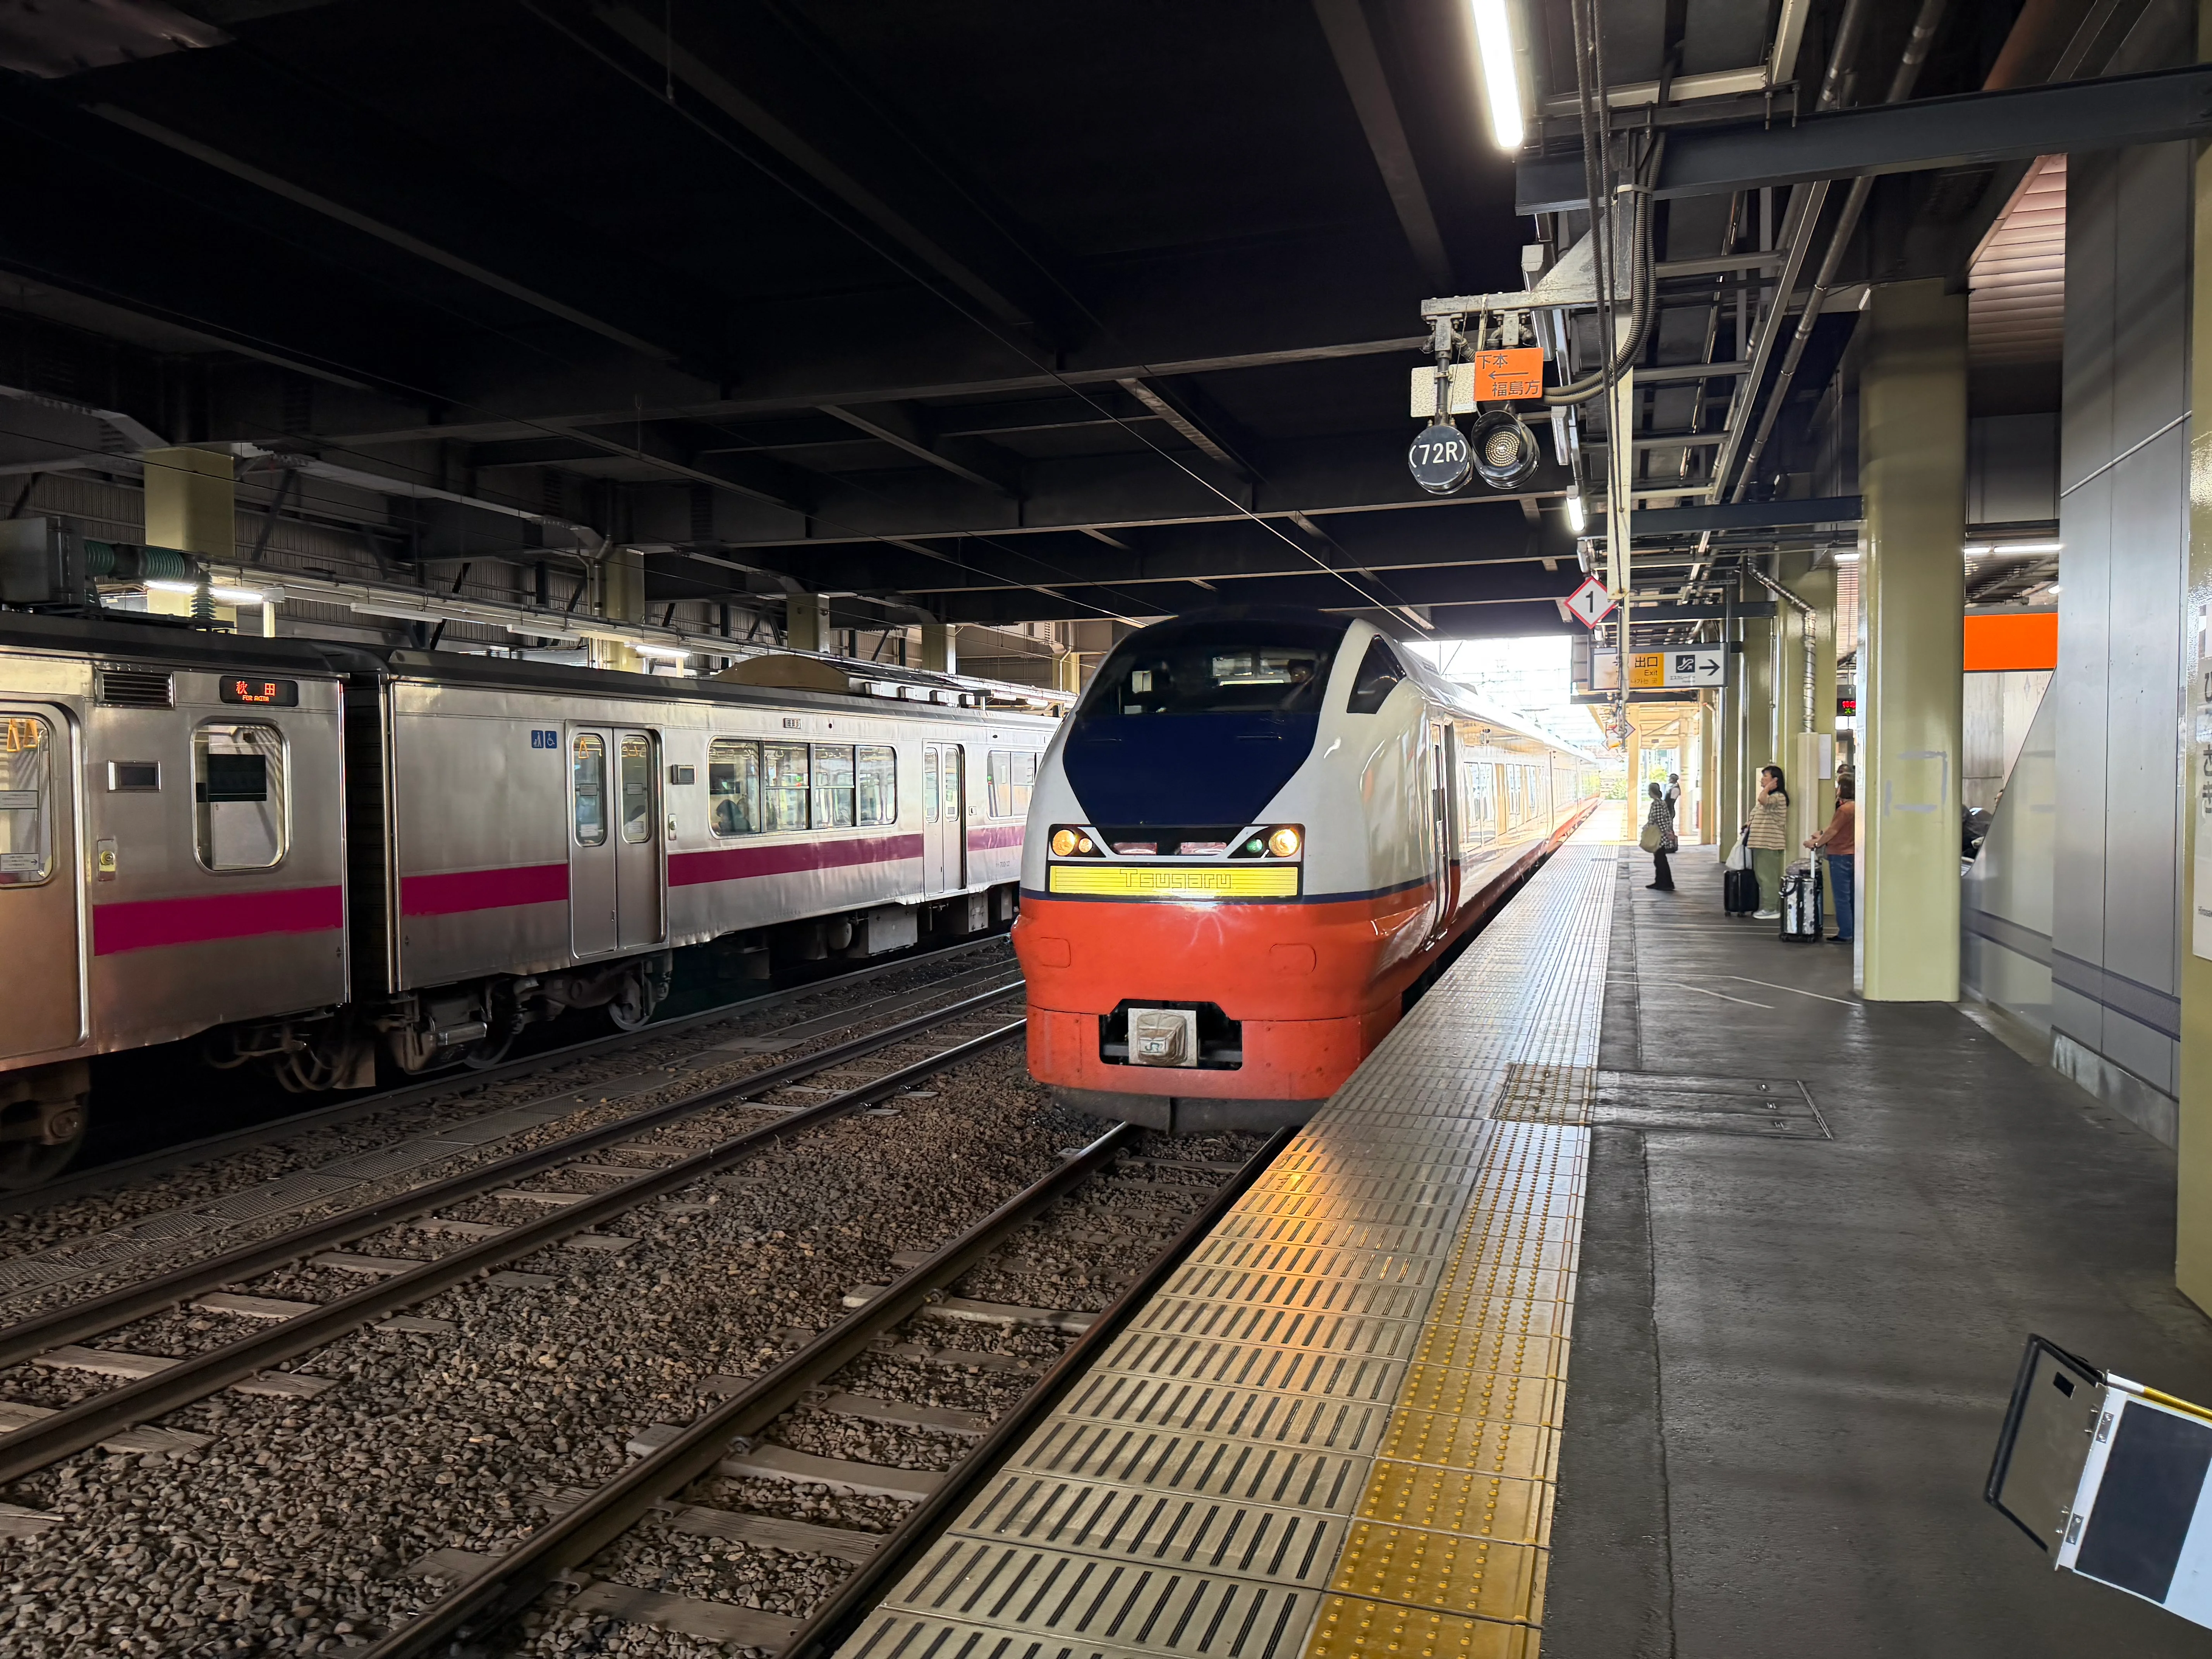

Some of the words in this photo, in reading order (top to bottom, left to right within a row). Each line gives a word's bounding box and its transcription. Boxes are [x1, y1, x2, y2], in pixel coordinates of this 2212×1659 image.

[1477, 353, 1508, 369] 下本
[1492, 380, 1540, 397] 福島方
[1409, 440, 1467, 468] (72R)
[1585, 591, 1594, 613] 1
[1635, 656, 1658, 668] 出口
[235, 680, 276, 696] 秋田
[1120, 869, 1231, 892] Tsugaru
